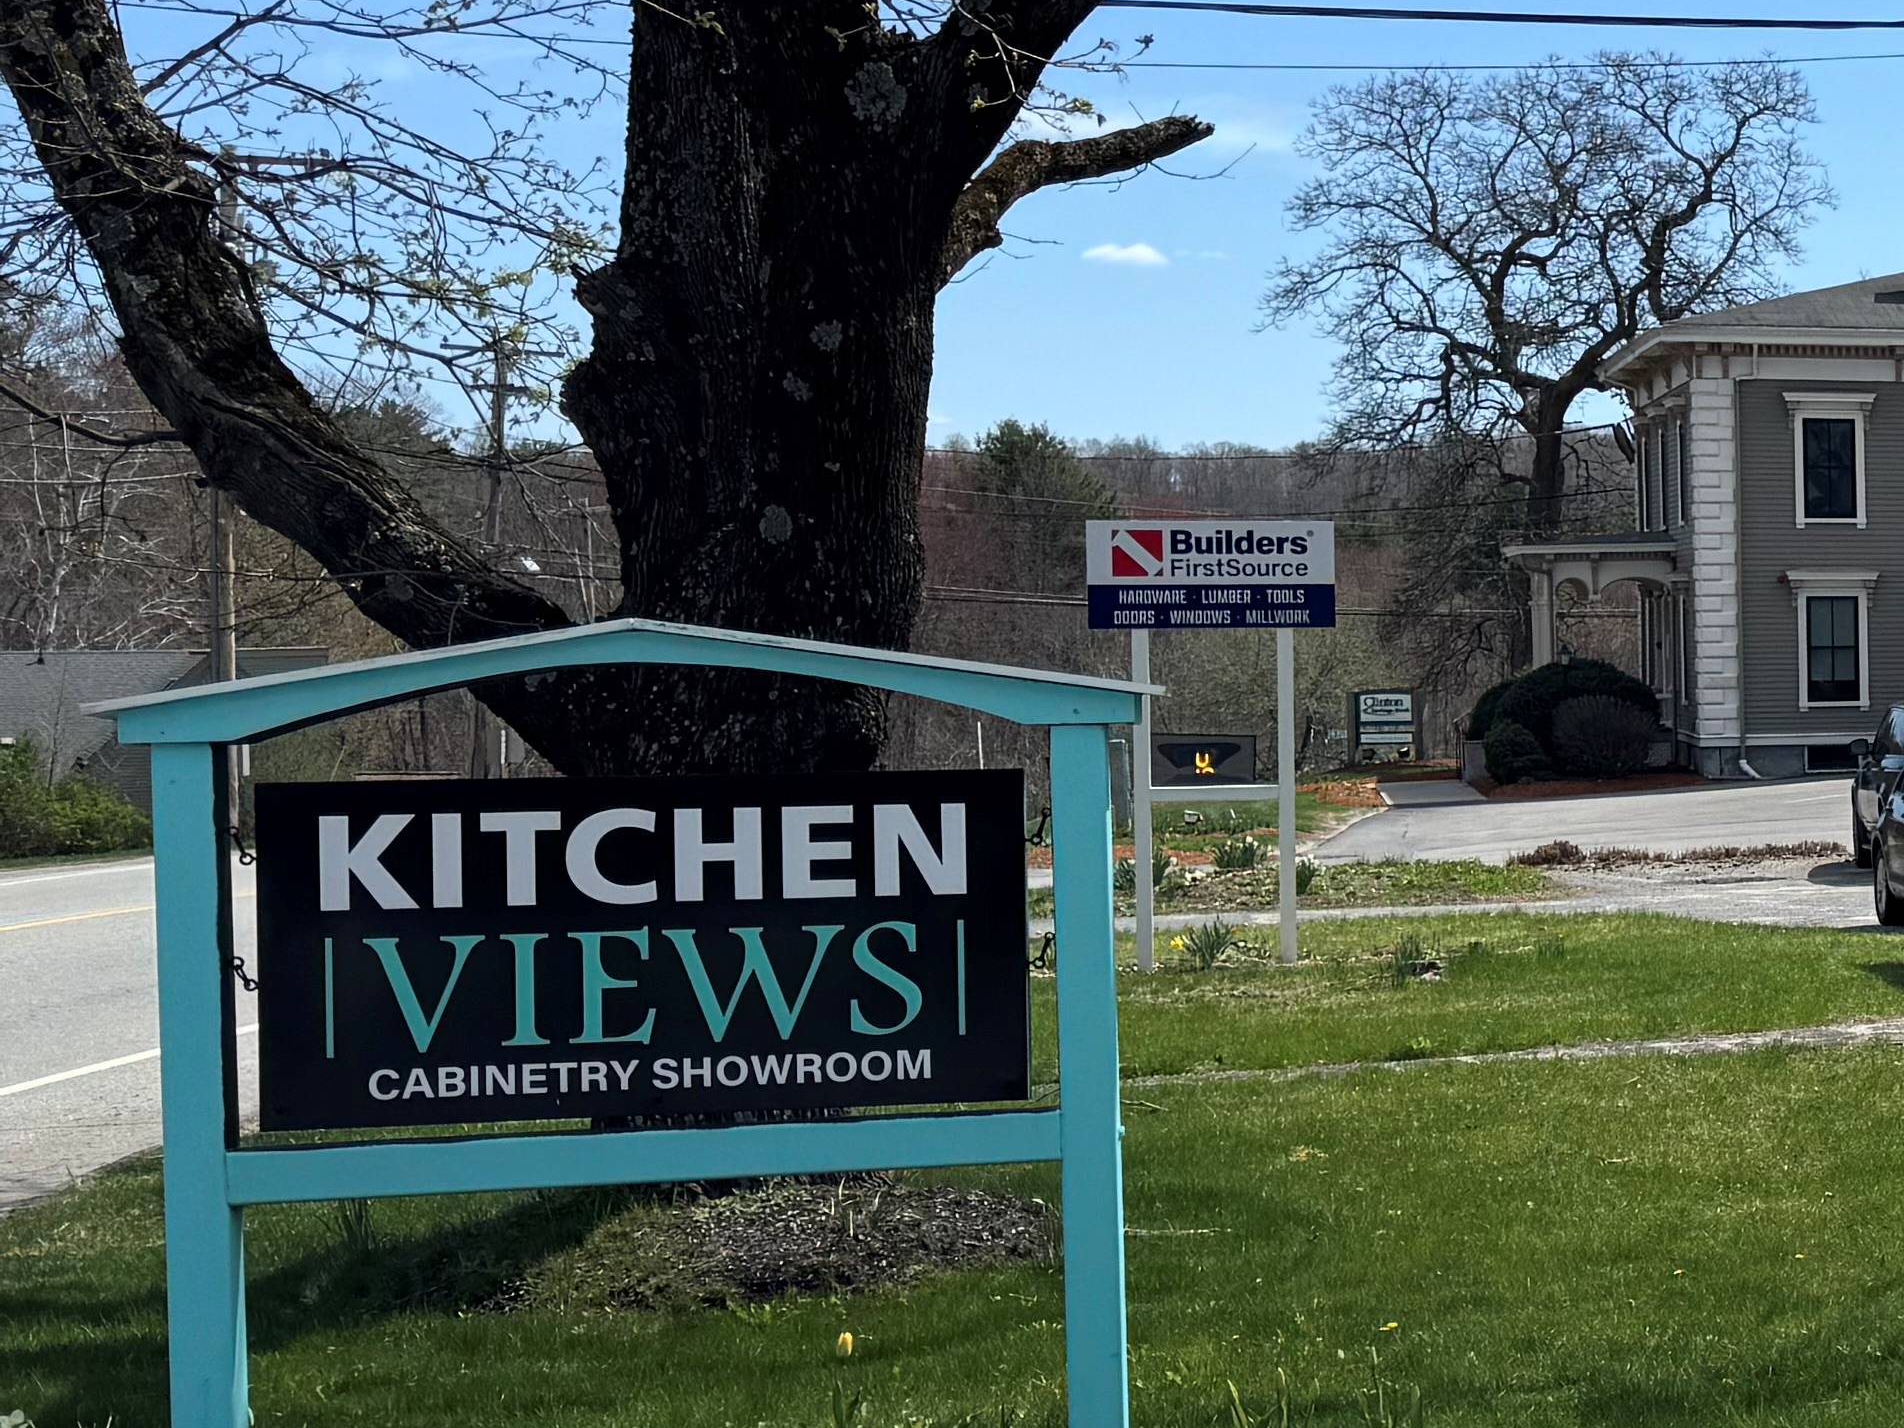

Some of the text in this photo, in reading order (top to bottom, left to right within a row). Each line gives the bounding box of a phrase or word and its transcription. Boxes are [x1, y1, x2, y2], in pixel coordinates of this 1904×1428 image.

[1169, 529, 1308, 555] Builders
[1170, 558, 1309, 577] FirstSource
[1119, 589, 1305, 605] HARDWARE LUMBER TOOLS
[1113, 609, 1310, 625] DOORS WINDOWS MILLWORK
[318, 802, 968, 912] KITCHEN
[362, 920, 923, 1053] VIEWS
[368, 1048, 932, 1101] CABINETRY SHOWROOM
